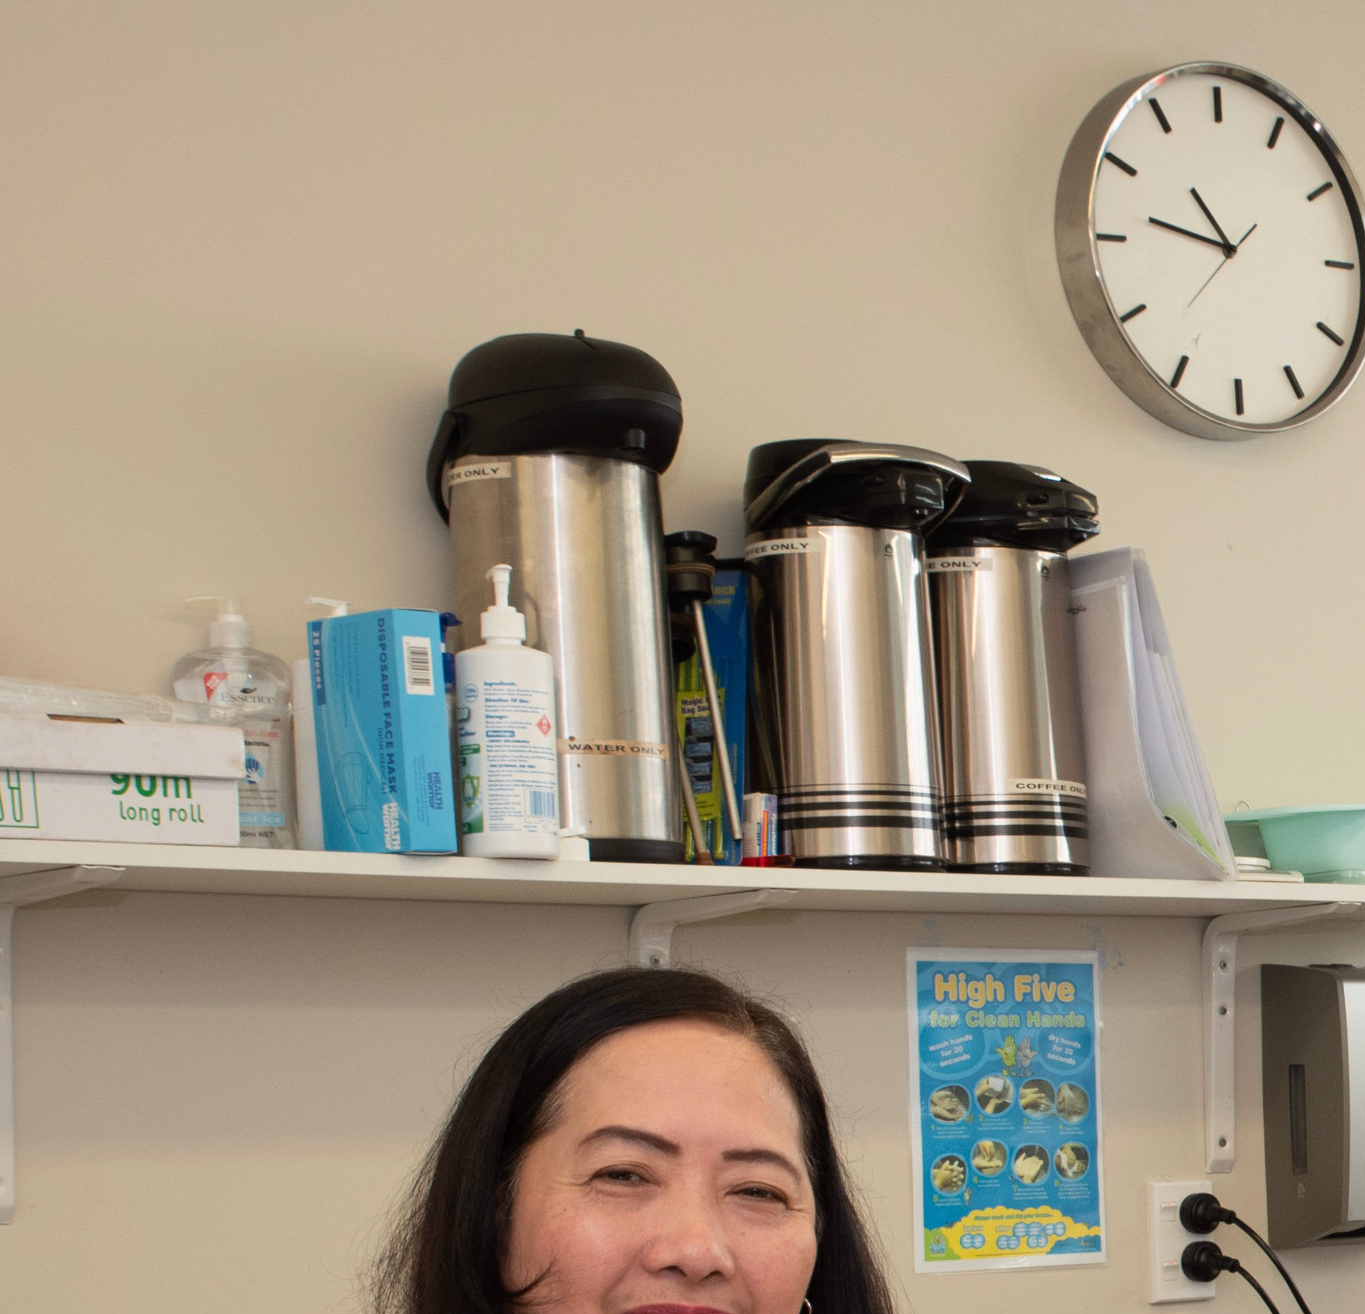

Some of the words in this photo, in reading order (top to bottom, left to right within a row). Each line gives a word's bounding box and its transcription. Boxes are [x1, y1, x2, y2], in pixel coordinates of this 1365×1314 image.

[464, 467, 500, 477] ONLY
[750, 546, 768, 554] FEE
[771, 542, 809, 551] ONLY
[312, 631, 321, 646] 25
[313, 650, 322, 690] Pieces
[378, 617, 391, 708] DISPOSABLE
[220, 692, 276, 704] Essence
[383, 709, 394, 749] FACE
[568, 743, 626, 752] WATER
[630, 746, 664, 755] ONLY
[386, 753, 398, 794] MASK
[433, 771, 444, 810] HEALTH
[1016, 782, 1068, 791] COFFEE
[119, 800, 161, 826] long
[168, 804, 204, 823] roll
[933, 973, 1005, 1009] High
[1014, 973, 1076, 1003] Five
[929, 1010, 960, 1028] for
[965, 1010, 1021, 1028] Clean
[1026, 1010, 1086, 1028] Hands
[929, 1039, 950, 1052] wash
[949, 1033, 973, 1046] hands
[940, 1048, 952, 1058] for
[953, 1045, 964, 1055] 20
[939, 1053, 972, 1068] seconds
